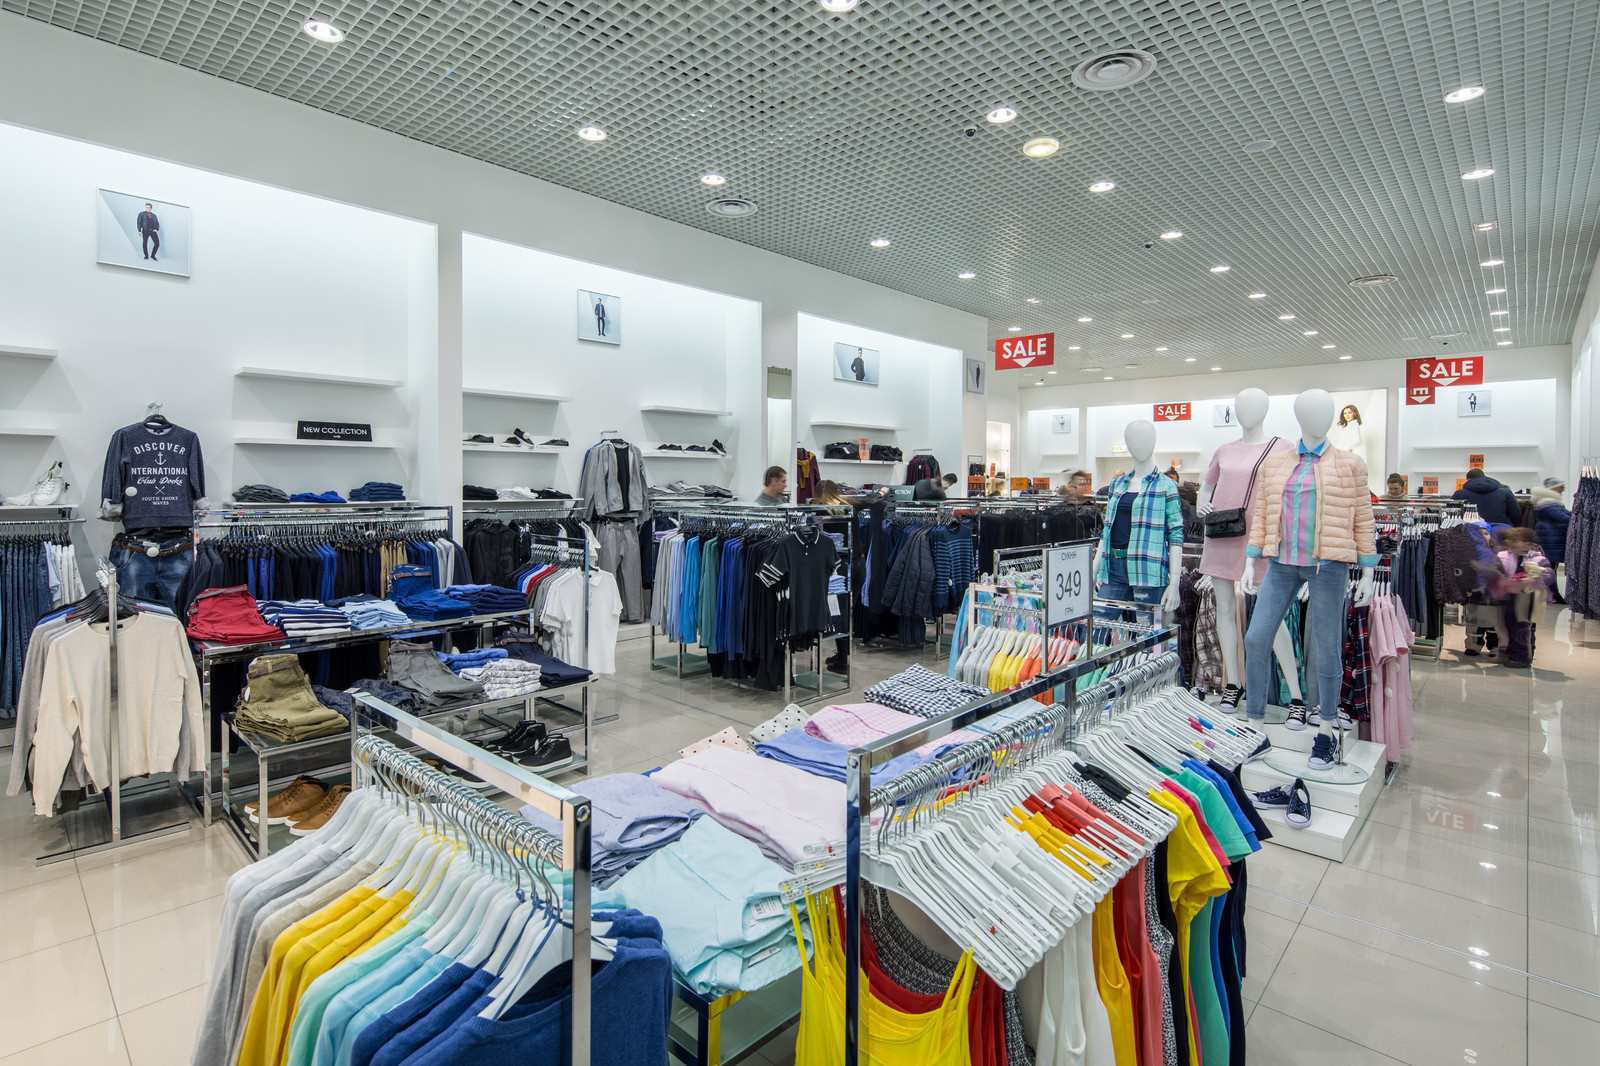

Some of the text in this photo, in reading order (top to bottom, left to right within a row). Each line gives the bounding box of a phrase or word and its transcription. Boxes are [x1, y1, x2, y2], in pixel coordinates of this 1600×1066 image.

[1002, 337, 1047, 359] SALE
[1419, 360, 1474, 379] SALE
[1157, 404, 1188, 416] SALE
[322, 427, 367, 435] COLLECTION
[134, 442, 186, 455] DISCOVER
[131, 467, 188, 475] NTERNATIONAL
[1056, 570, 1081, 600] 349
[1065, 607, 1073, 616] ГРН
